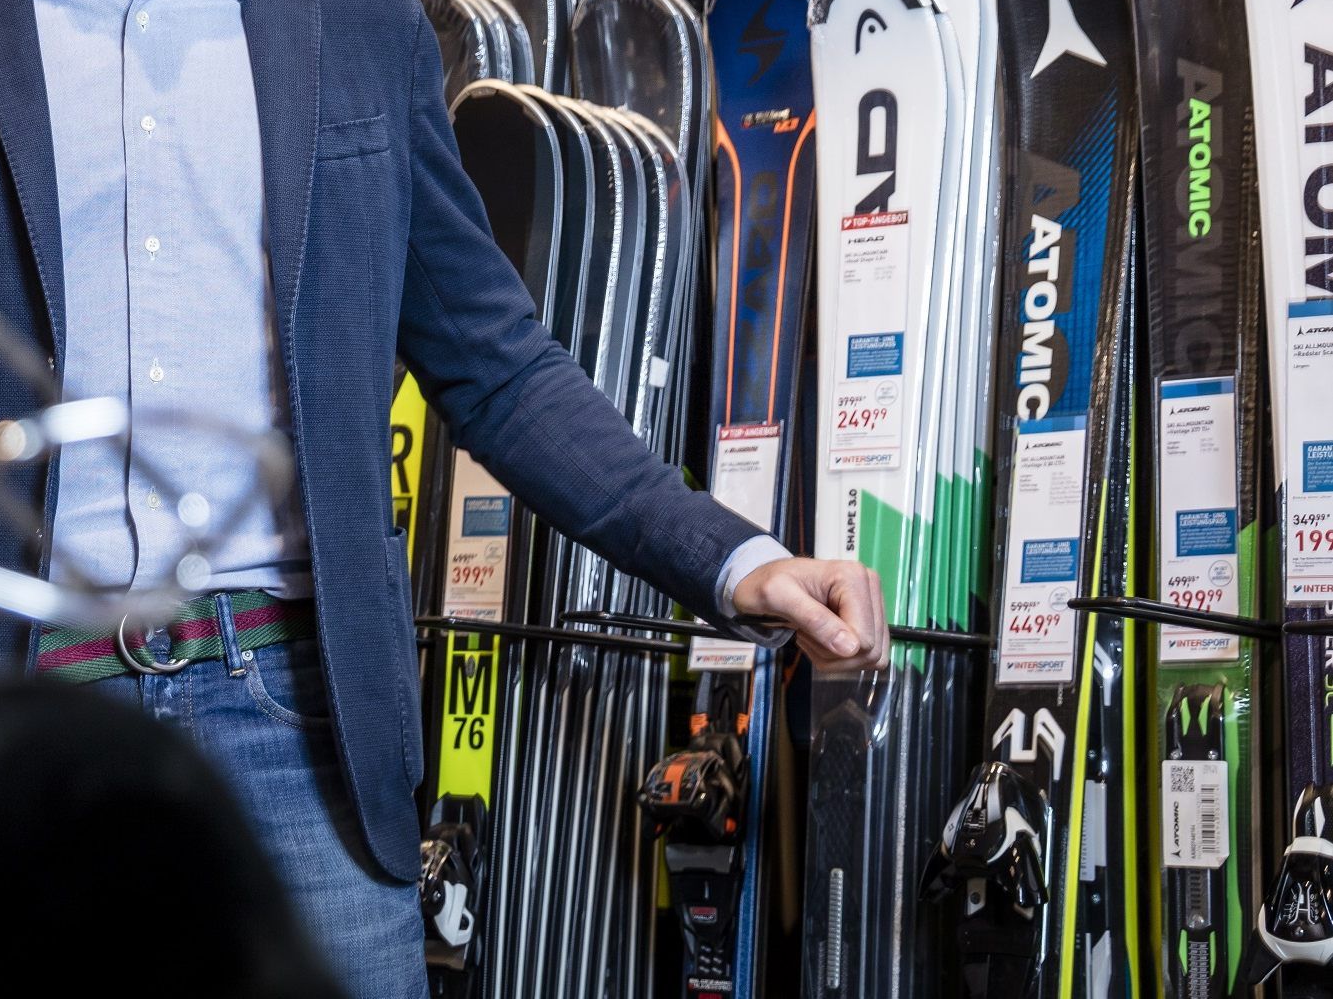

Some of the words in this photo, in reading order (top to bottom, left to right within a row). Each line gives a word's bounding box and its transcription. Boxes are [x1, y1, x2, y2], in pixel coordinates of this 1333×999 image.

[1188, 97, 1212, 239] ATOMIC
[853, 213, 907, 226] TOP-ANGEBOT
[848, 235, 885, 244] HEAD
[1018, 214, 1062, 421] ATOMIC
[838, 408, 887, 430] 249,99
[1177, 405, 1211, 413] ATOMIC
[842, 455, 892, 463] INTERSPORT
[849, 488, 858, 508] 3.0
[846, 512, 856, 551] SHAPE
[452, 566, 494, 587] 399,99
[455, 609, 496, 617] INTERSPORT
[1009, 614, 1061, 636] 449,99
[1176, 639, 1231, 648] INTERSPORT
[1014, 661, 1065, 669] INTERSPORT
[453, 717, 485, 750] 76
